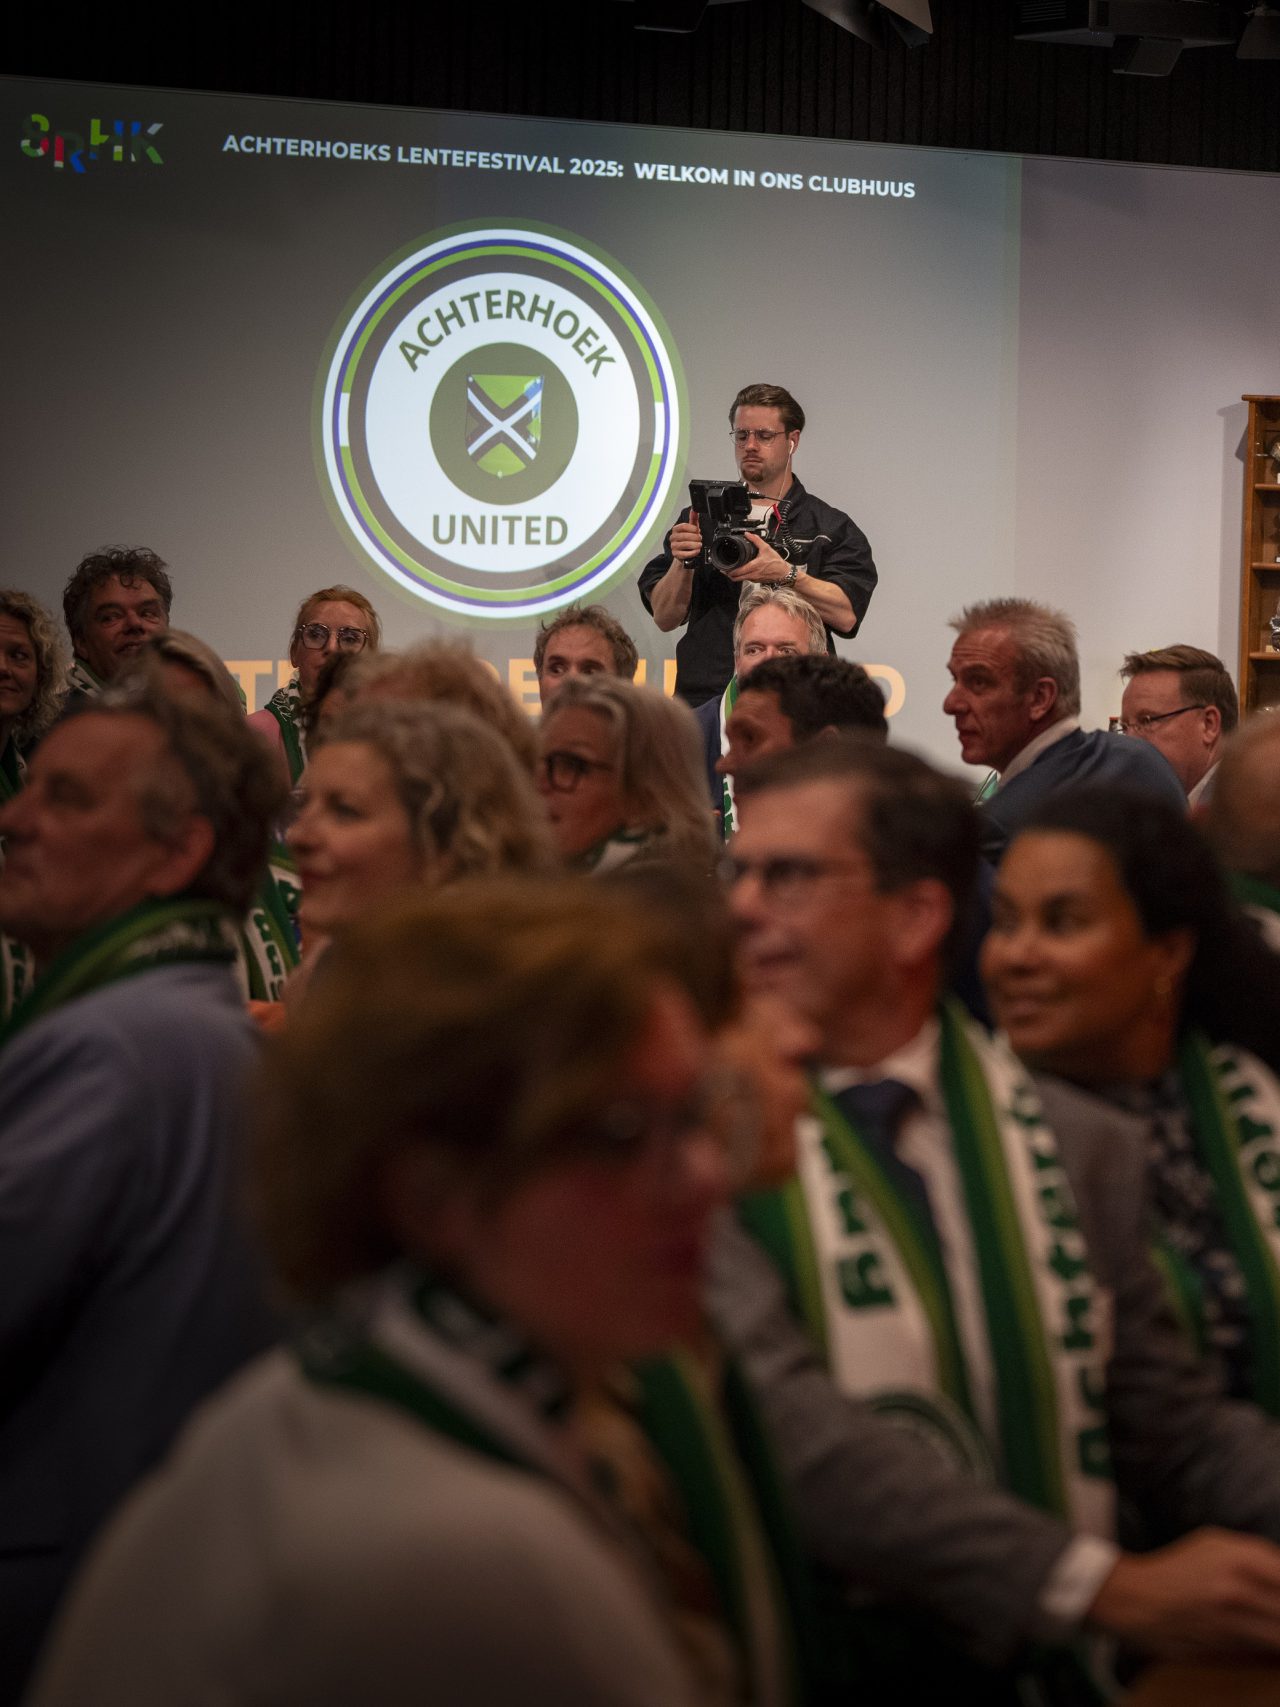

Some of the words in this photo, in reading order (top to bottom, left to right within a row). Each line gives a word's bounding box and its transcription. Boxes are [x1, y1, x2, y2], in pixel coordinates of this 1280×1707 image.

[222, 134, 391, 162] ACHTERHOEKS
[397, 146, 565, 175] LENTEFESTIVAL
[569, 157, 625, 177] 2025:
[634, 162, 729, 185] WELKOM
[734, 169, 756, 187] IN
[760, 171, 803, 190] ONS
[808, 175, 916, 198] CLUBHUUS
[398, 289, 617, 377] ACHTERHOEK
[432, 514, 569, 546] UNITED
